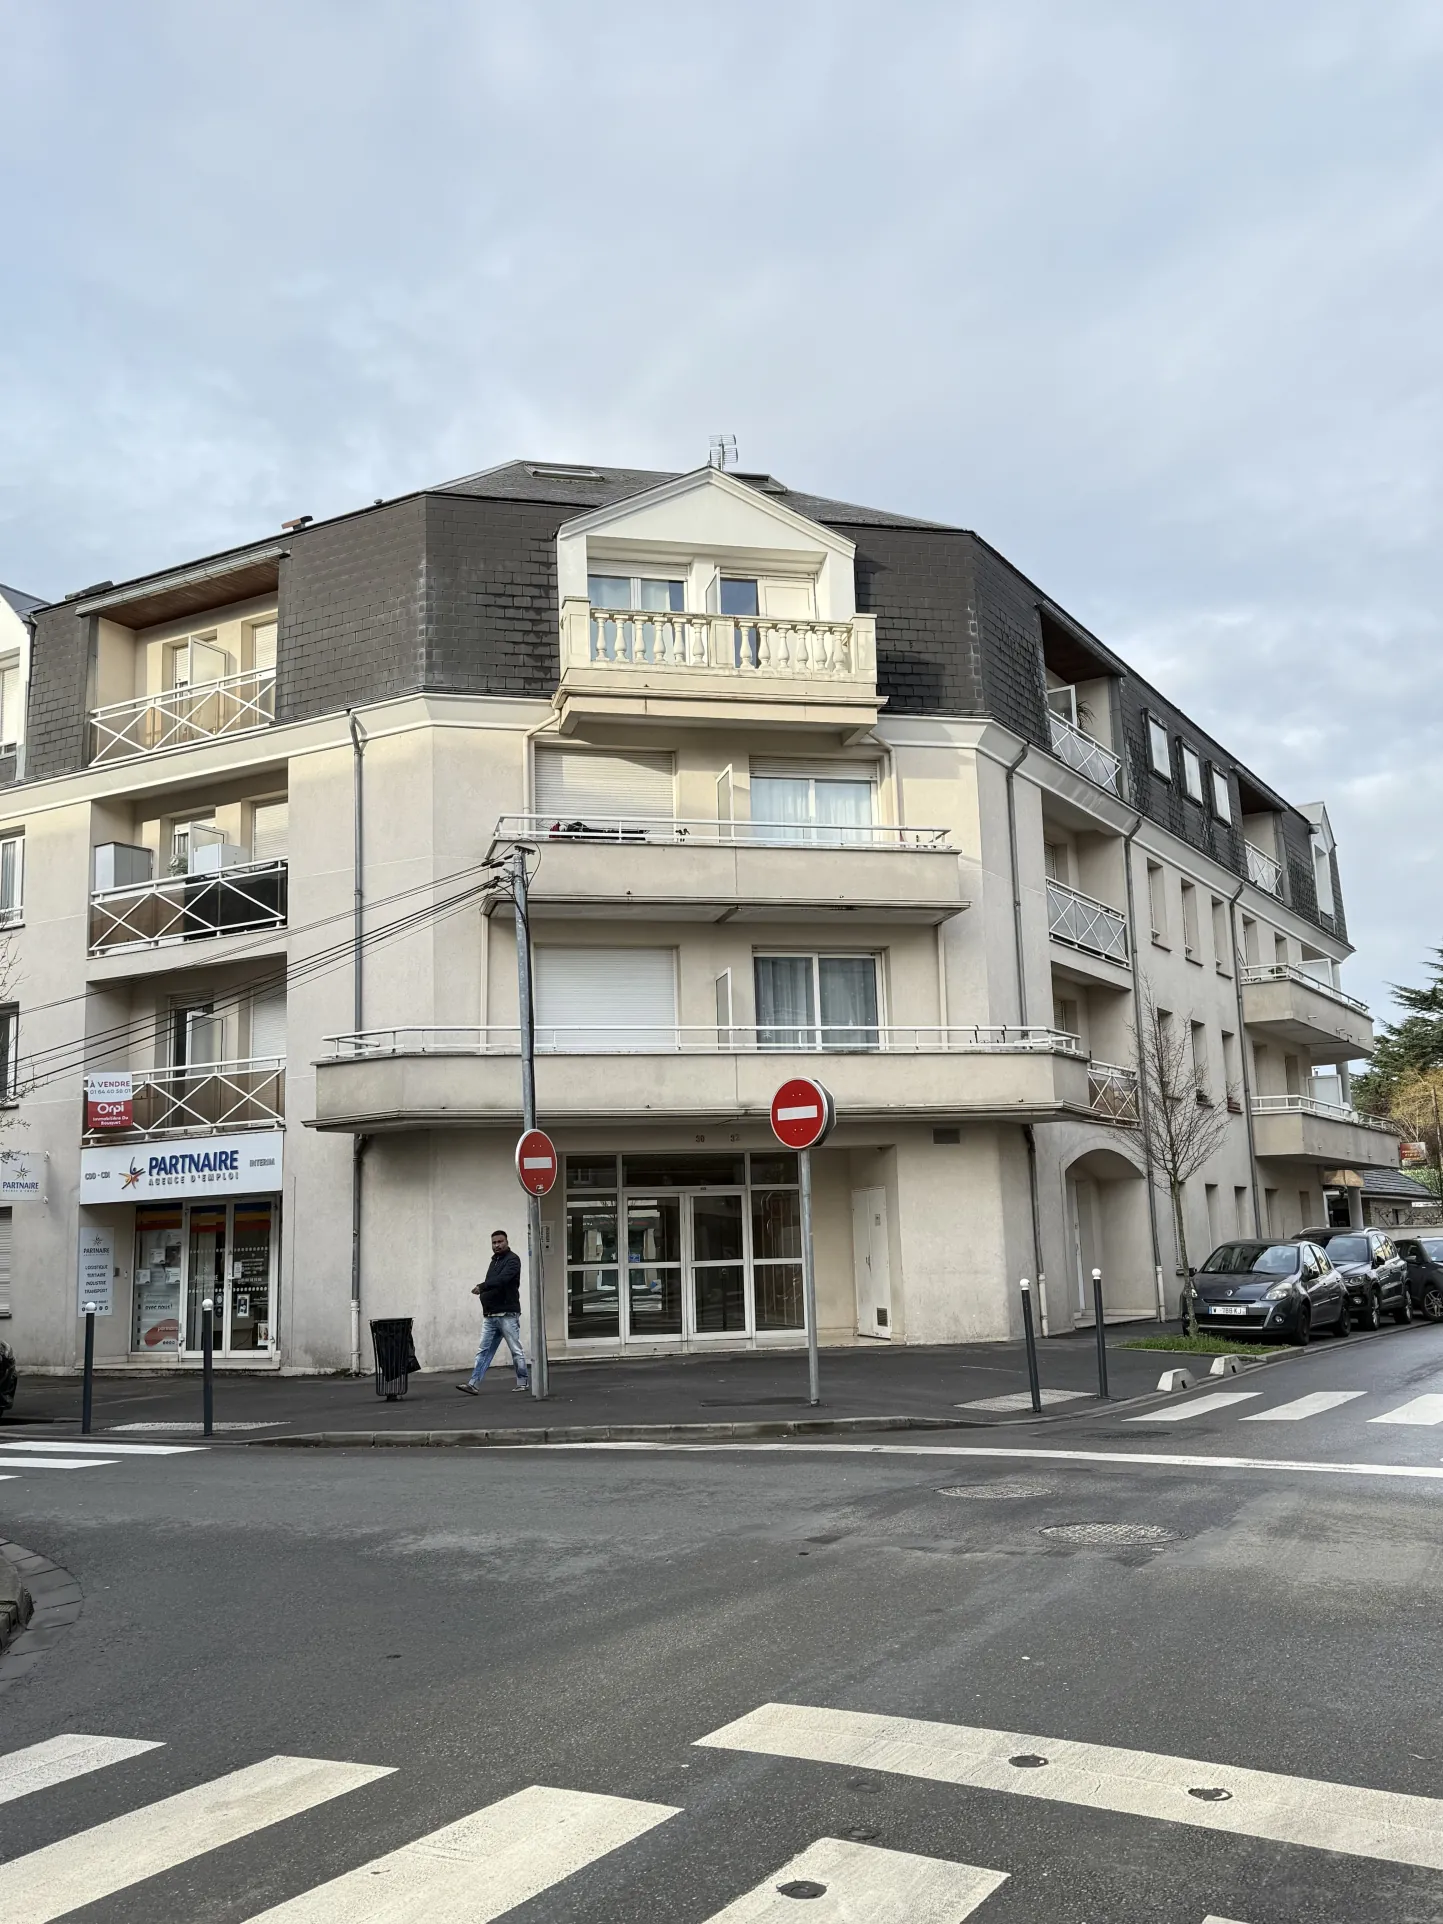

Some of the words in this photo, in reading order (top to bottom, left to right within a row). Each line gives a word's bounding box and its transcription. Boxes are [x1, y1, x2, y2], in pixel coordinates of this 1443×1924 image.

[90, 1080, 95, 1088] À
[97, 1101, 125, 1116] Orpi
[695, 1134, 705, 1142] 30
[148, 1150, 239, 1177] PARTNAIRE
[249, 1157, 276, 1167] INTERIM
[148, 1176, 185, 1186] AGENCE
[191, 1171, 239, 1183] D'EMPLOI
[2, 1181, 40, 1190] PARTNAIRE
